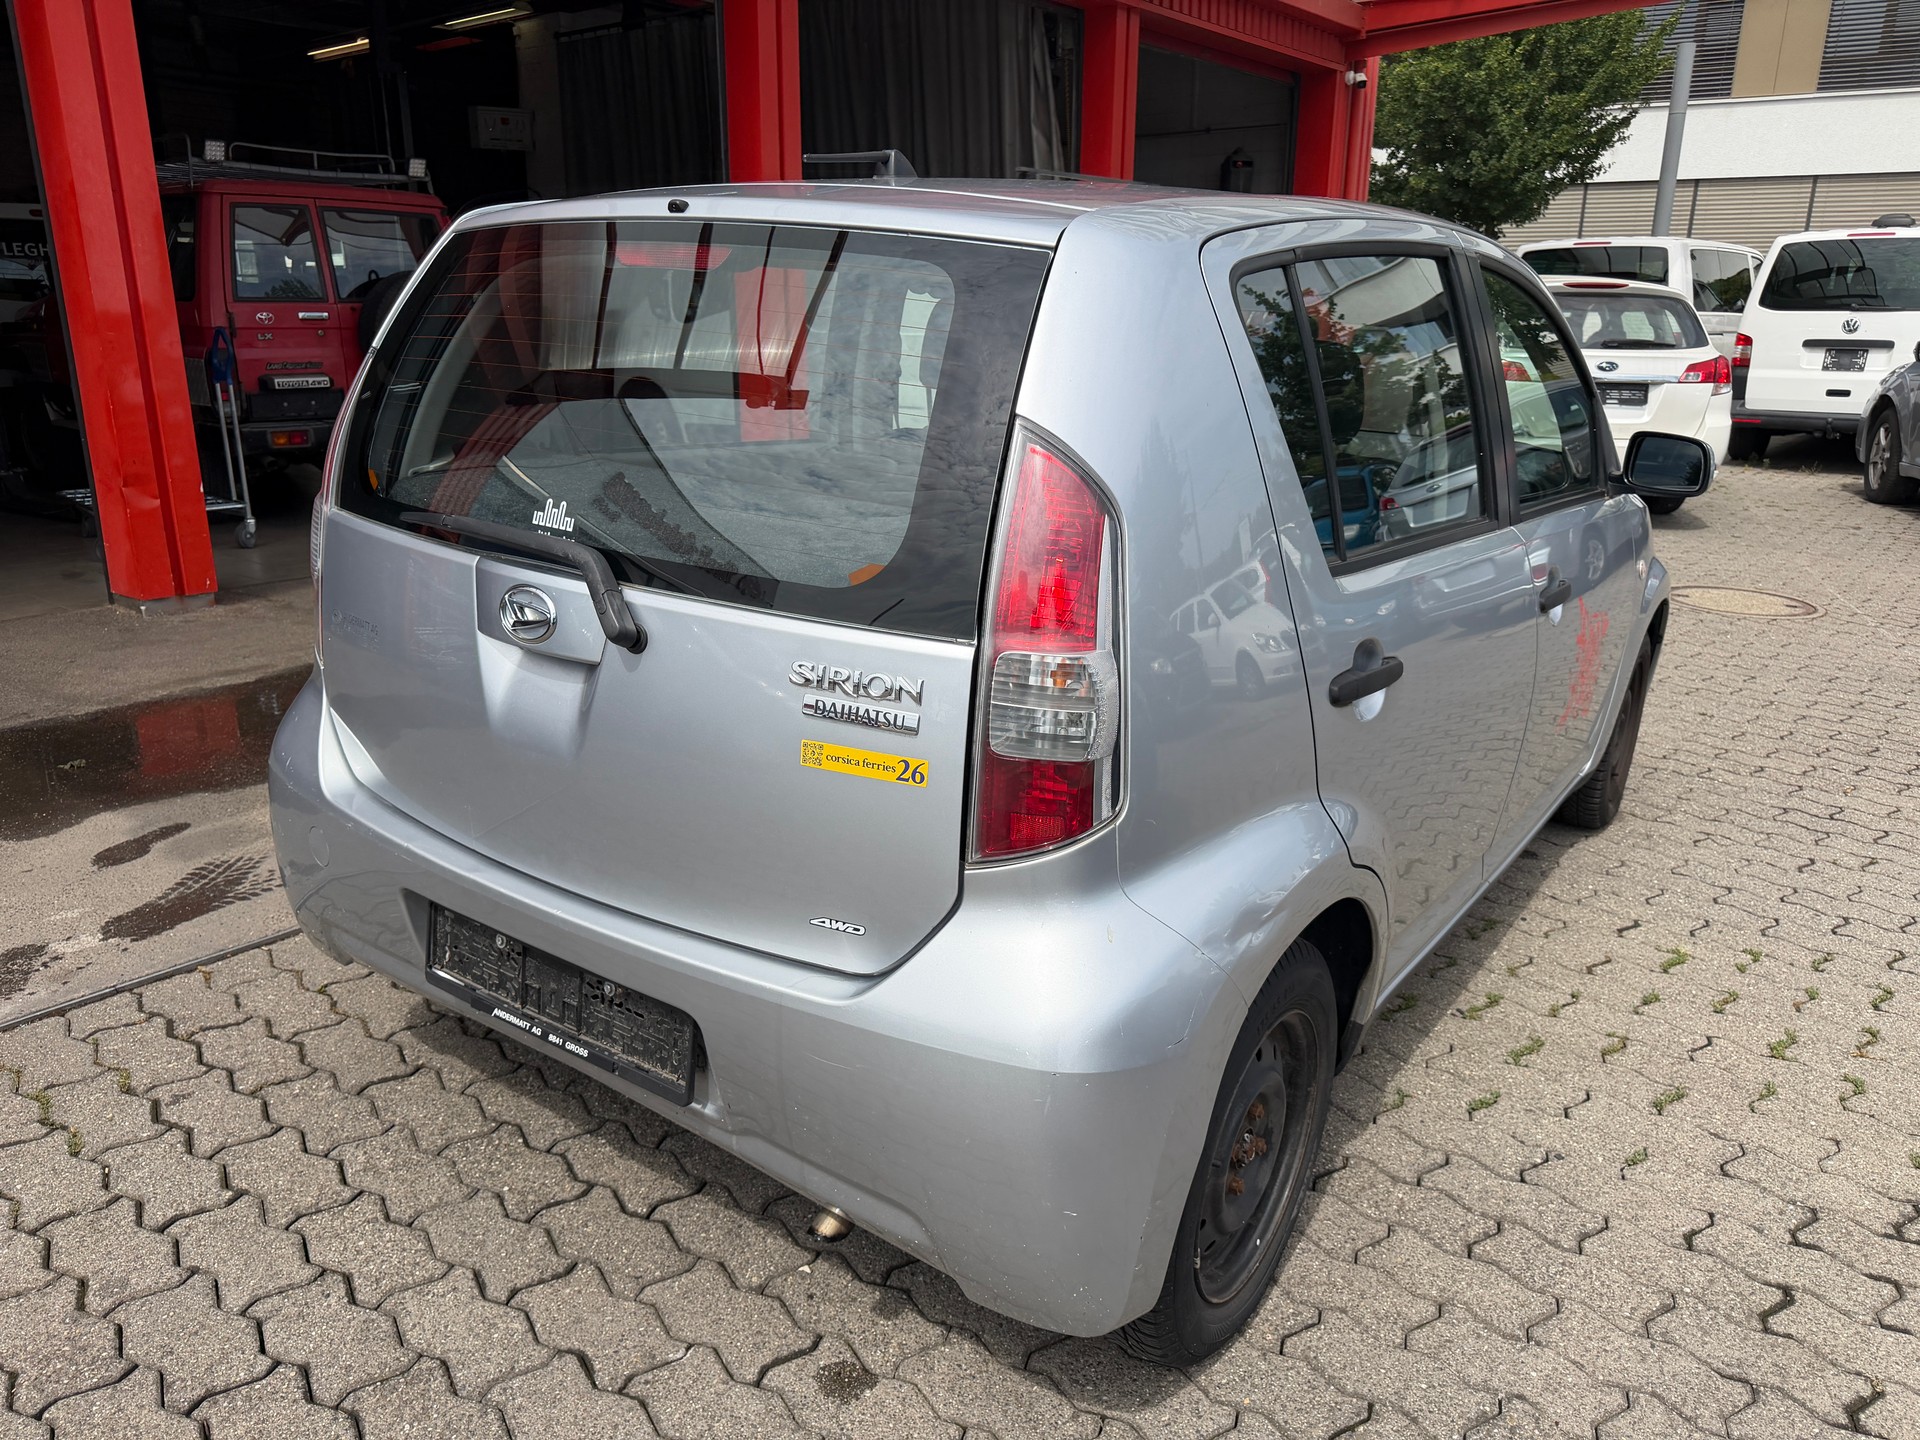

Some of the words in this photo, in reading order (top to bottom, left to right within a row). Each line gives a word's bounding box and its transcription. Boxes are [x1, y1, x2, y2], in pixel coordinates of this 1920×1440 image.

[277, 380, 309, 388] TOYOTA
[310, 379, 329, 387] 4WD
[789, 660, 924, 706] SIRION
[813, 699, 906, 731] DAIHATSU
[825, 753, 860, 768] corsica
[862, 758, 897, 773] ferries
[895, 759, 926, 785] 26
[810, 917, 866, 936] 4WD
[491, 1007, 531, 1031] ANDERMATT
[531, 1025, 543, 1036] AG
[547, 1033, 563, 1047] 8841
[565, 1041, 590, 1058] GROSS
